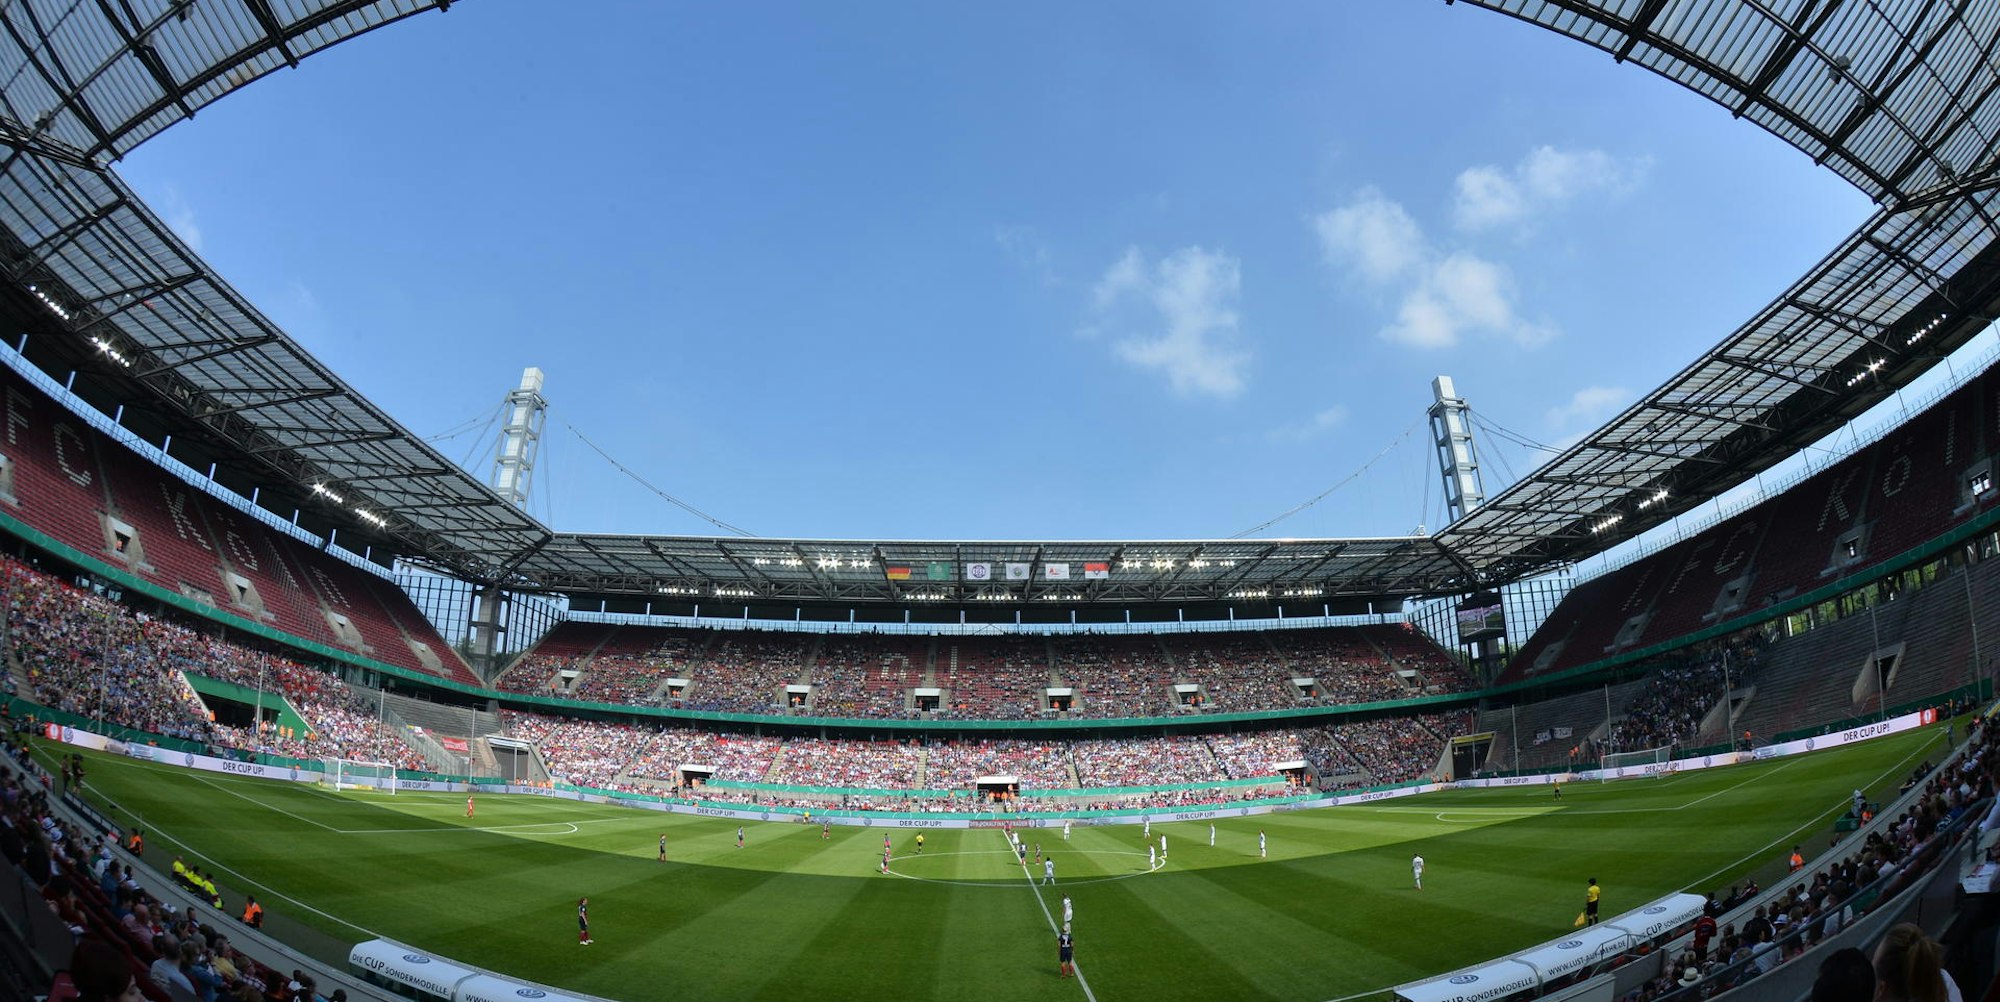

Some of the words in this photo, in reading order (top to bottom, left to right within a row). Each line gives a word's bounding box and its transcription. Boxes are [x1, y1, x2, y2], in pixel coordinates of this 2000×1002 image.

[1843, 730, 1858, 741] DER
[1860, 727, 1875, 738] CUP
[1877, 723, 1890, 734] UP!
[222, 762, 236, 771] DER
[238, 764, 251, 774] CUP
[253, 766, 265, 775] UP!
[1646, 922, 1662, 936] CUP
[352, 953, 363, 964] DIE
[364, 956, 385, 971] CUP
